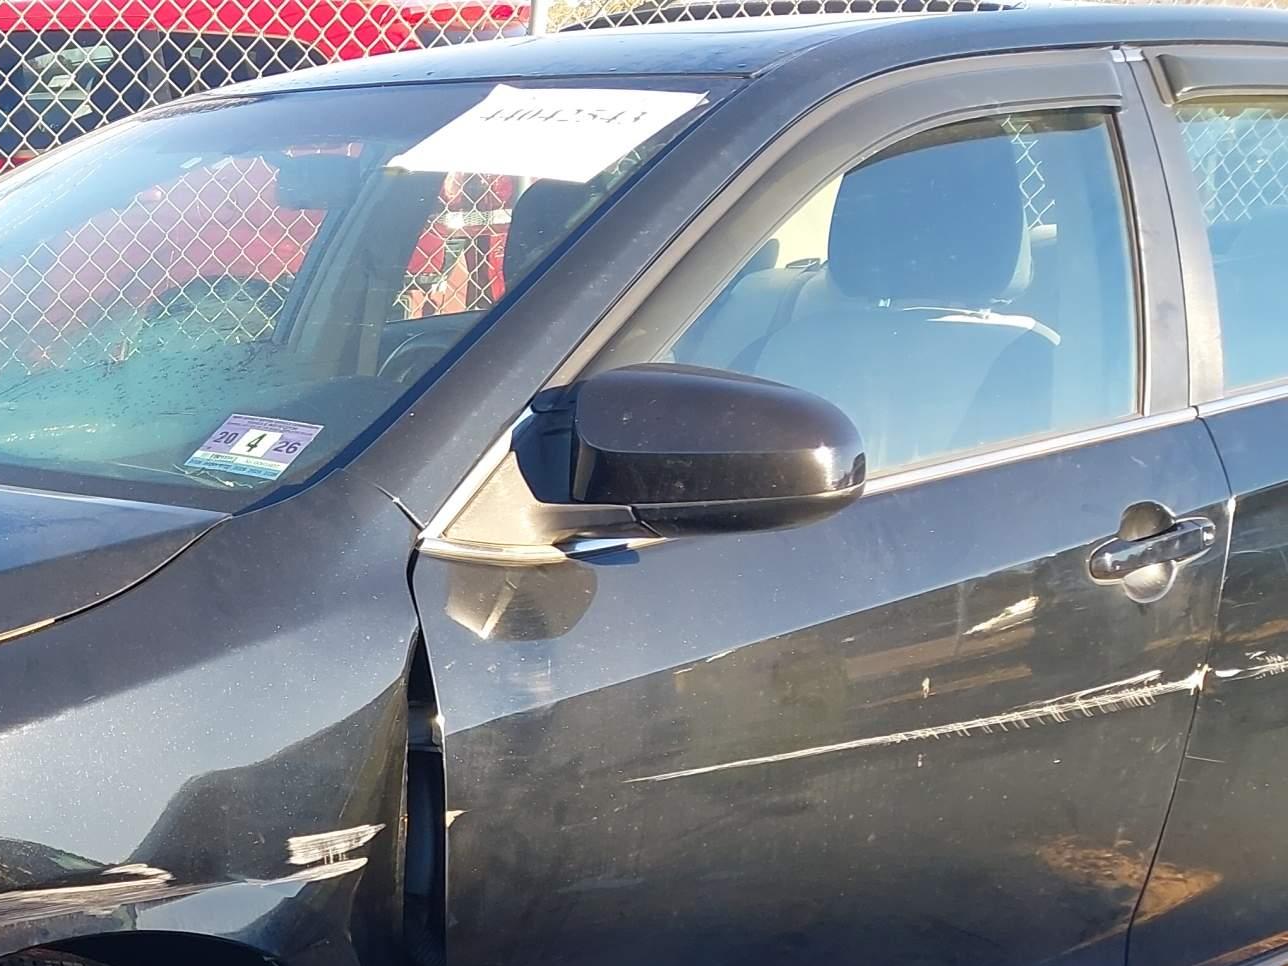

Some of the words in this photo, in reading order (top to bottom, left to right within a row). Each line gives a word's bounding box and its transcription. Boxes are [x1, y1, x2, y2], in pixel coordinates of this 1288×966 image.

[213, 430, 240, 445] 20
[246, 432, 267, 453] 4
[273, 440, 302, 455] 26
